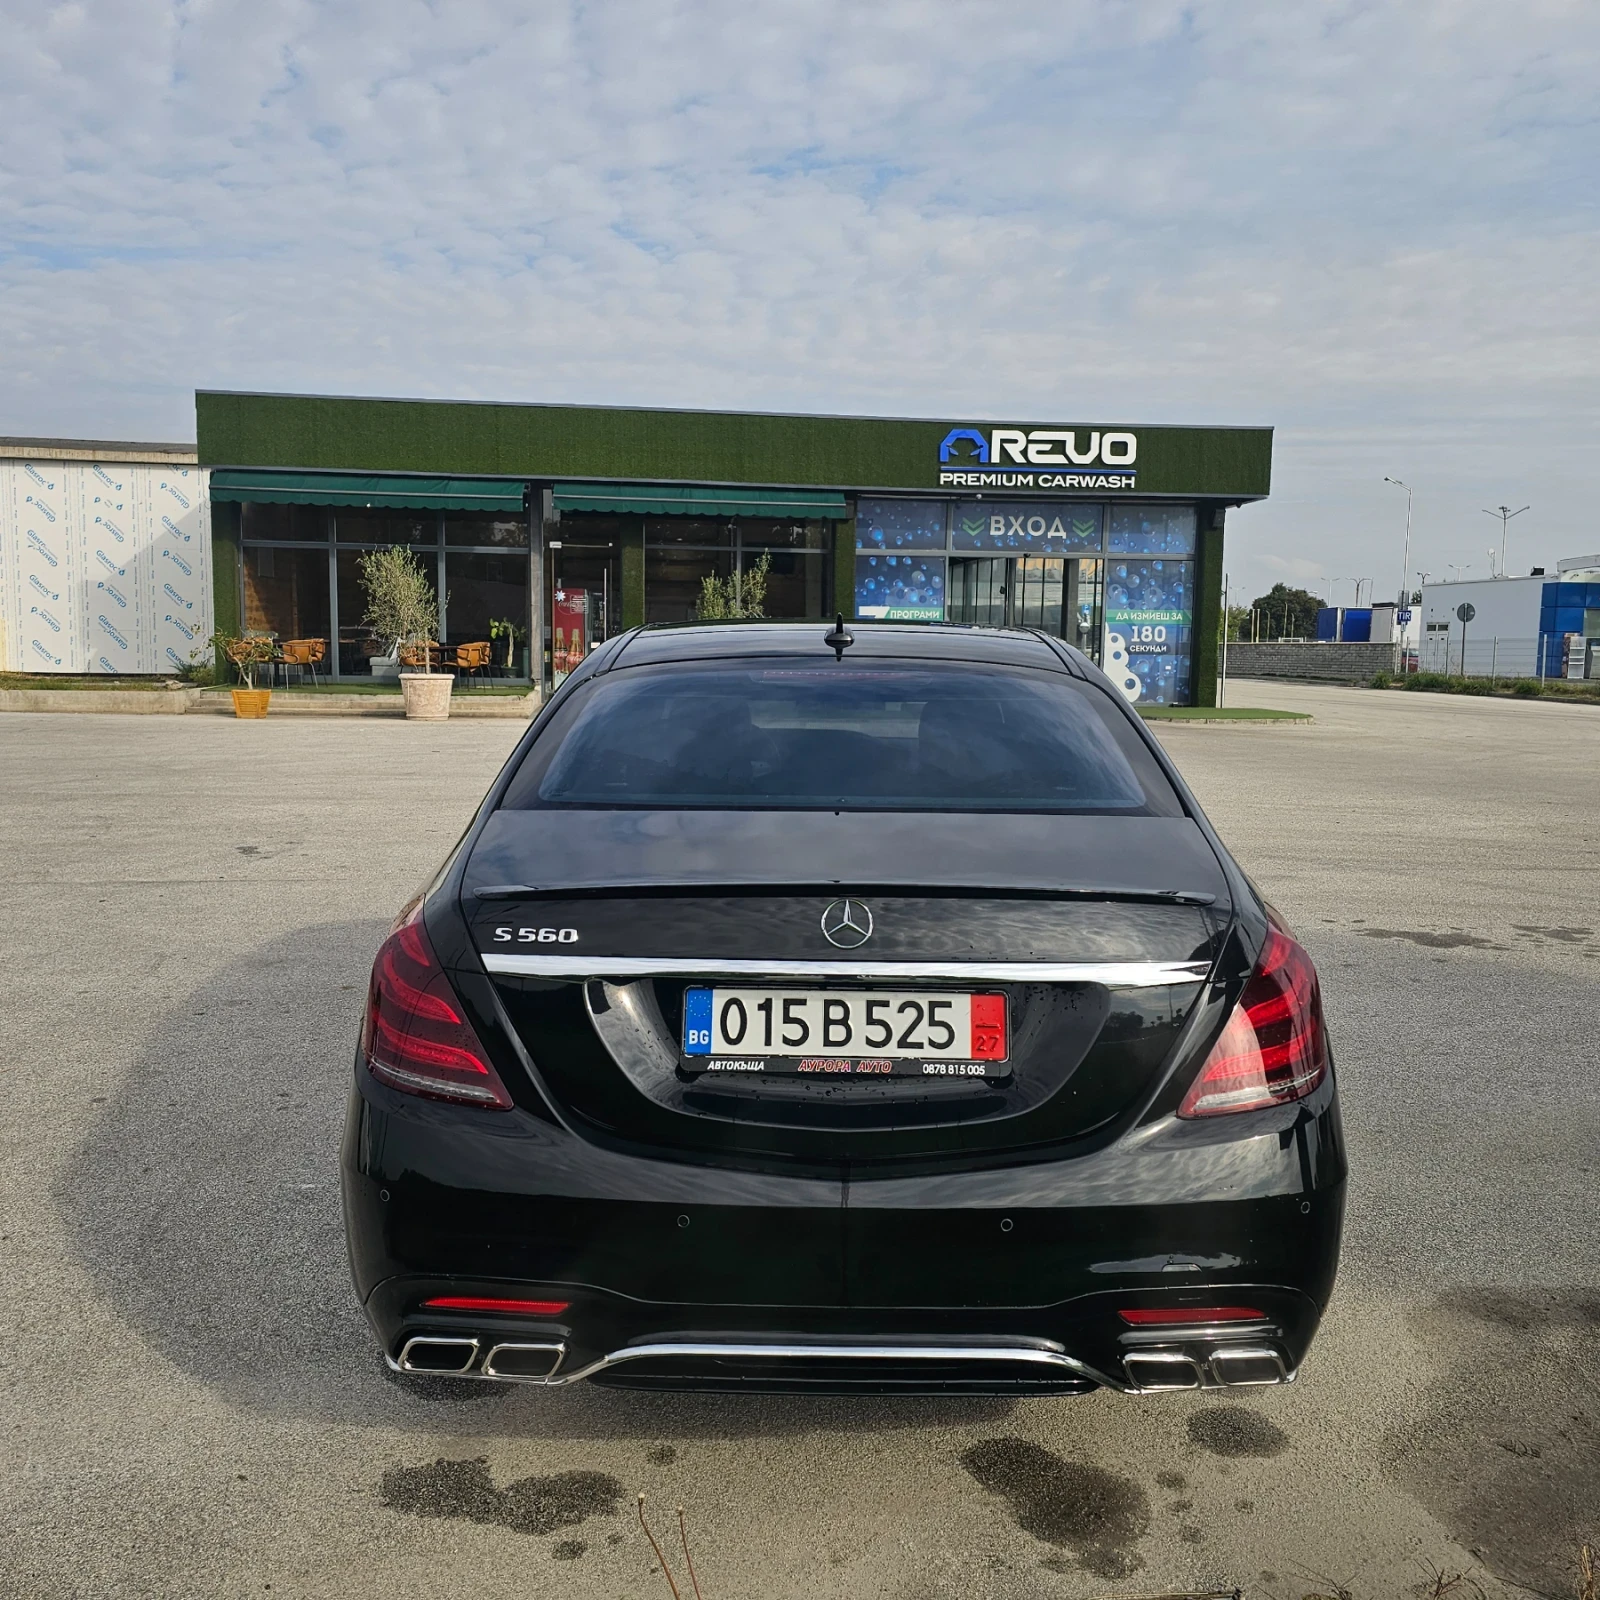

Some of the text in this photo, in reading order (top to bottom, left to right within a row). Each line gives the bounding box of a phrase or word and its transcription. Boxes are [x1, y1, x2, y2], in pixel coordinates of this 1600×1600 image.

[25, 464, 46, 485] Glasroc
[93, 464, 114, 486] Glasroc
[940, 472, 1135, 488] PREMIUM CARWASH
[34, 501, 56, 522] Glasroc
[990, 515, 1066, 539] ВХОД
[96, 550, 117, 571] Glasroc
[30, 574, 51, 596] Glasroc
[164, 583, 186, 604] Glasroc
[105, 586, 127, 608] Glasroc
[890, 610, 940, 619] ПРОГРАМИ
[1116, 612, 1183, 620] ДА ИЗМИЕШ ЗА
[1398, 611, 1411, 620] TIR
[1131, 625, 1166, 642] 180
[32, 639, 53, 661] Glasroc
[1129, 645, 1167, 653] СЕКУНДИ
[100, 656, 118, 673] Glasro
[493, 927, 578, 943] S 560
[688, 1030, 709, 1045] BG
[975, 1034, 1000, 1052] 27
[707, 1060, 765, 1072] АВТОКЪЩА
[798, 1059, 893, 1073] АУРОРА АУТО
[922, 1063, 985, 1076] 0878 815 005
